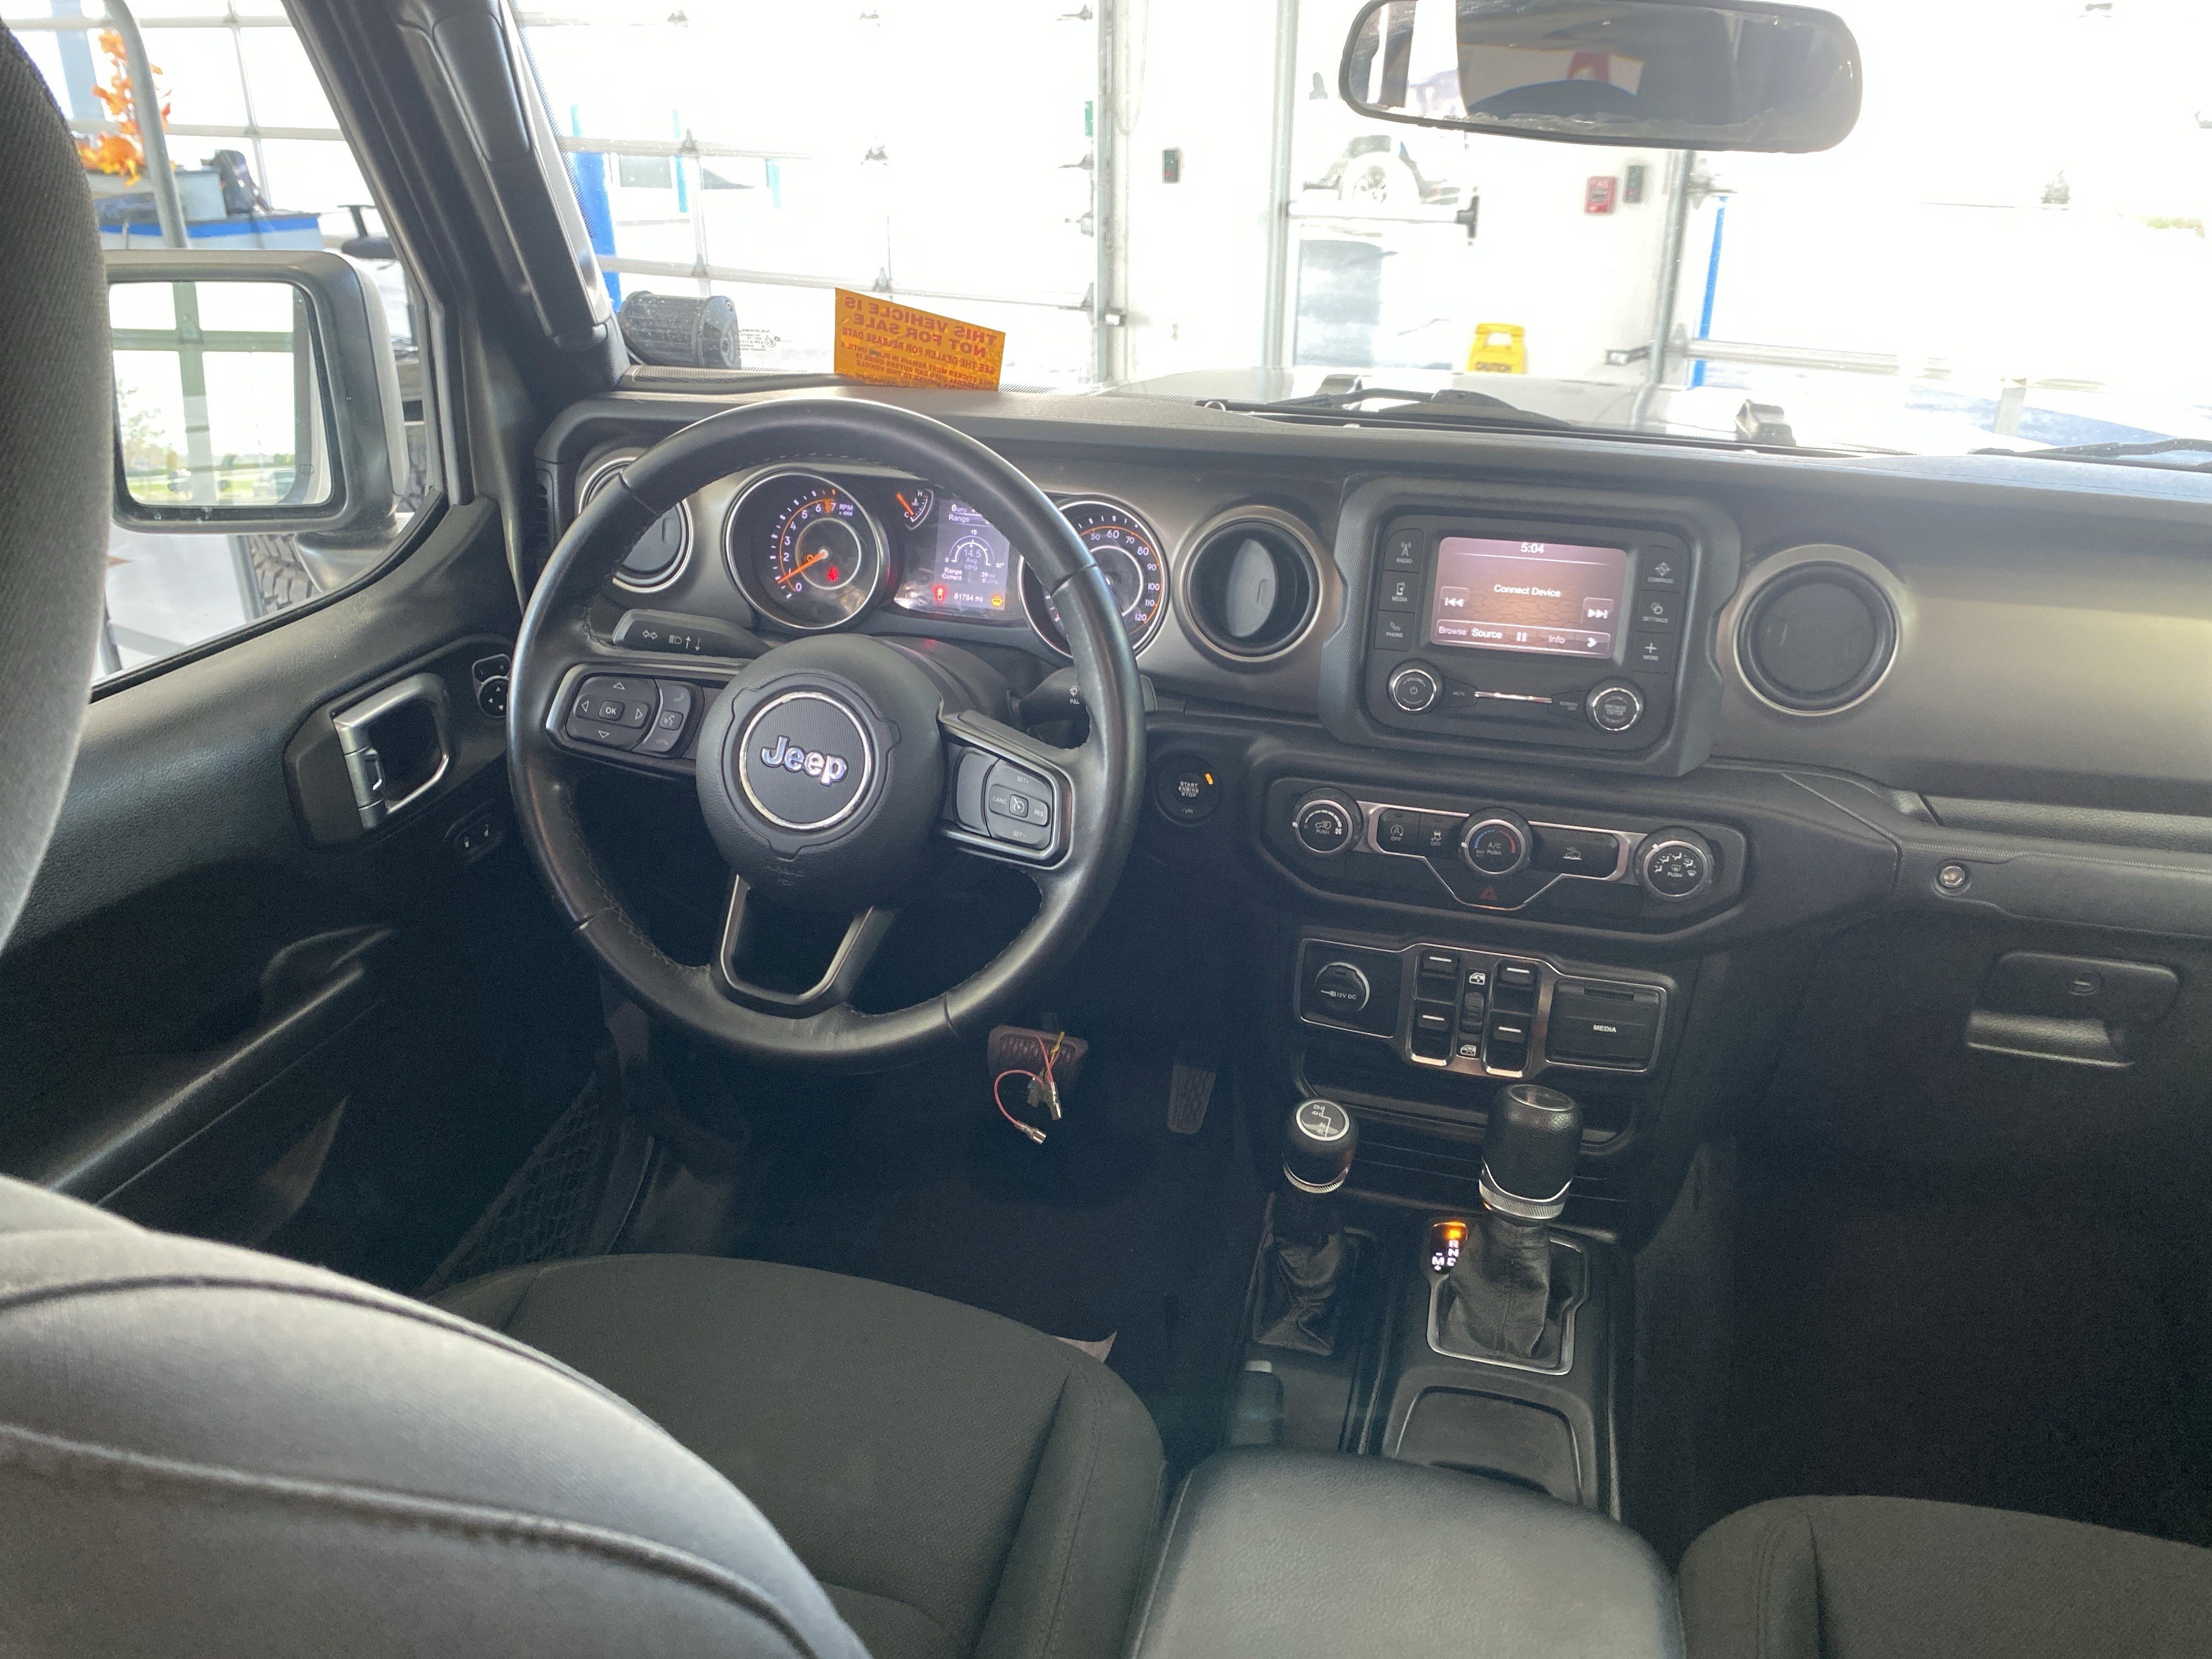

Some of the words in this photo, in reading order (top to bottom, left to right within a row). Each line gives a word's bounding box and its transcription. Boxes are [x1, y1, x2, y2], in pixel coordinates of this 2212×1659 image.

[815, 504, 821, 512] 6
[830, 503, 836, 511] 7
[949, 514, 969, 523] Range
[790, 521, 796, 531] 4
[1107, 529, 1119, 539] 60
[785, 536, 791, 545] 3
[1126, 536, 1135, 544] 70
[1137, 547, 1149, 556] 80
[1520, 542, 1545, 554] 5:04
[783, 552, 789, 562] 2
[795, 583, 802, 591] 0
[1148, 583, 1160, 591] 100
[1494, 584, 1530, 596] Connect
[1532, 587, 1561, 597] Device
[1135, 613, 1147, 622] 120
[1438, 627, 1467, 636] Browse
[1471, 628, 1503, 640] Source
[1548, 635, 1565, 644] Info
[606, 707, 617, 715] OK
[761, 736, 848, 785] Jeep
[992, 796, 1007, 805] CANC
[1593, 1024, 1617, 1033] MEDIA
[1449, 1239, 1459, 1248] R
[1448, 1248, 1459, 1257] N
[1432, 1256, 1444, 1265] M
